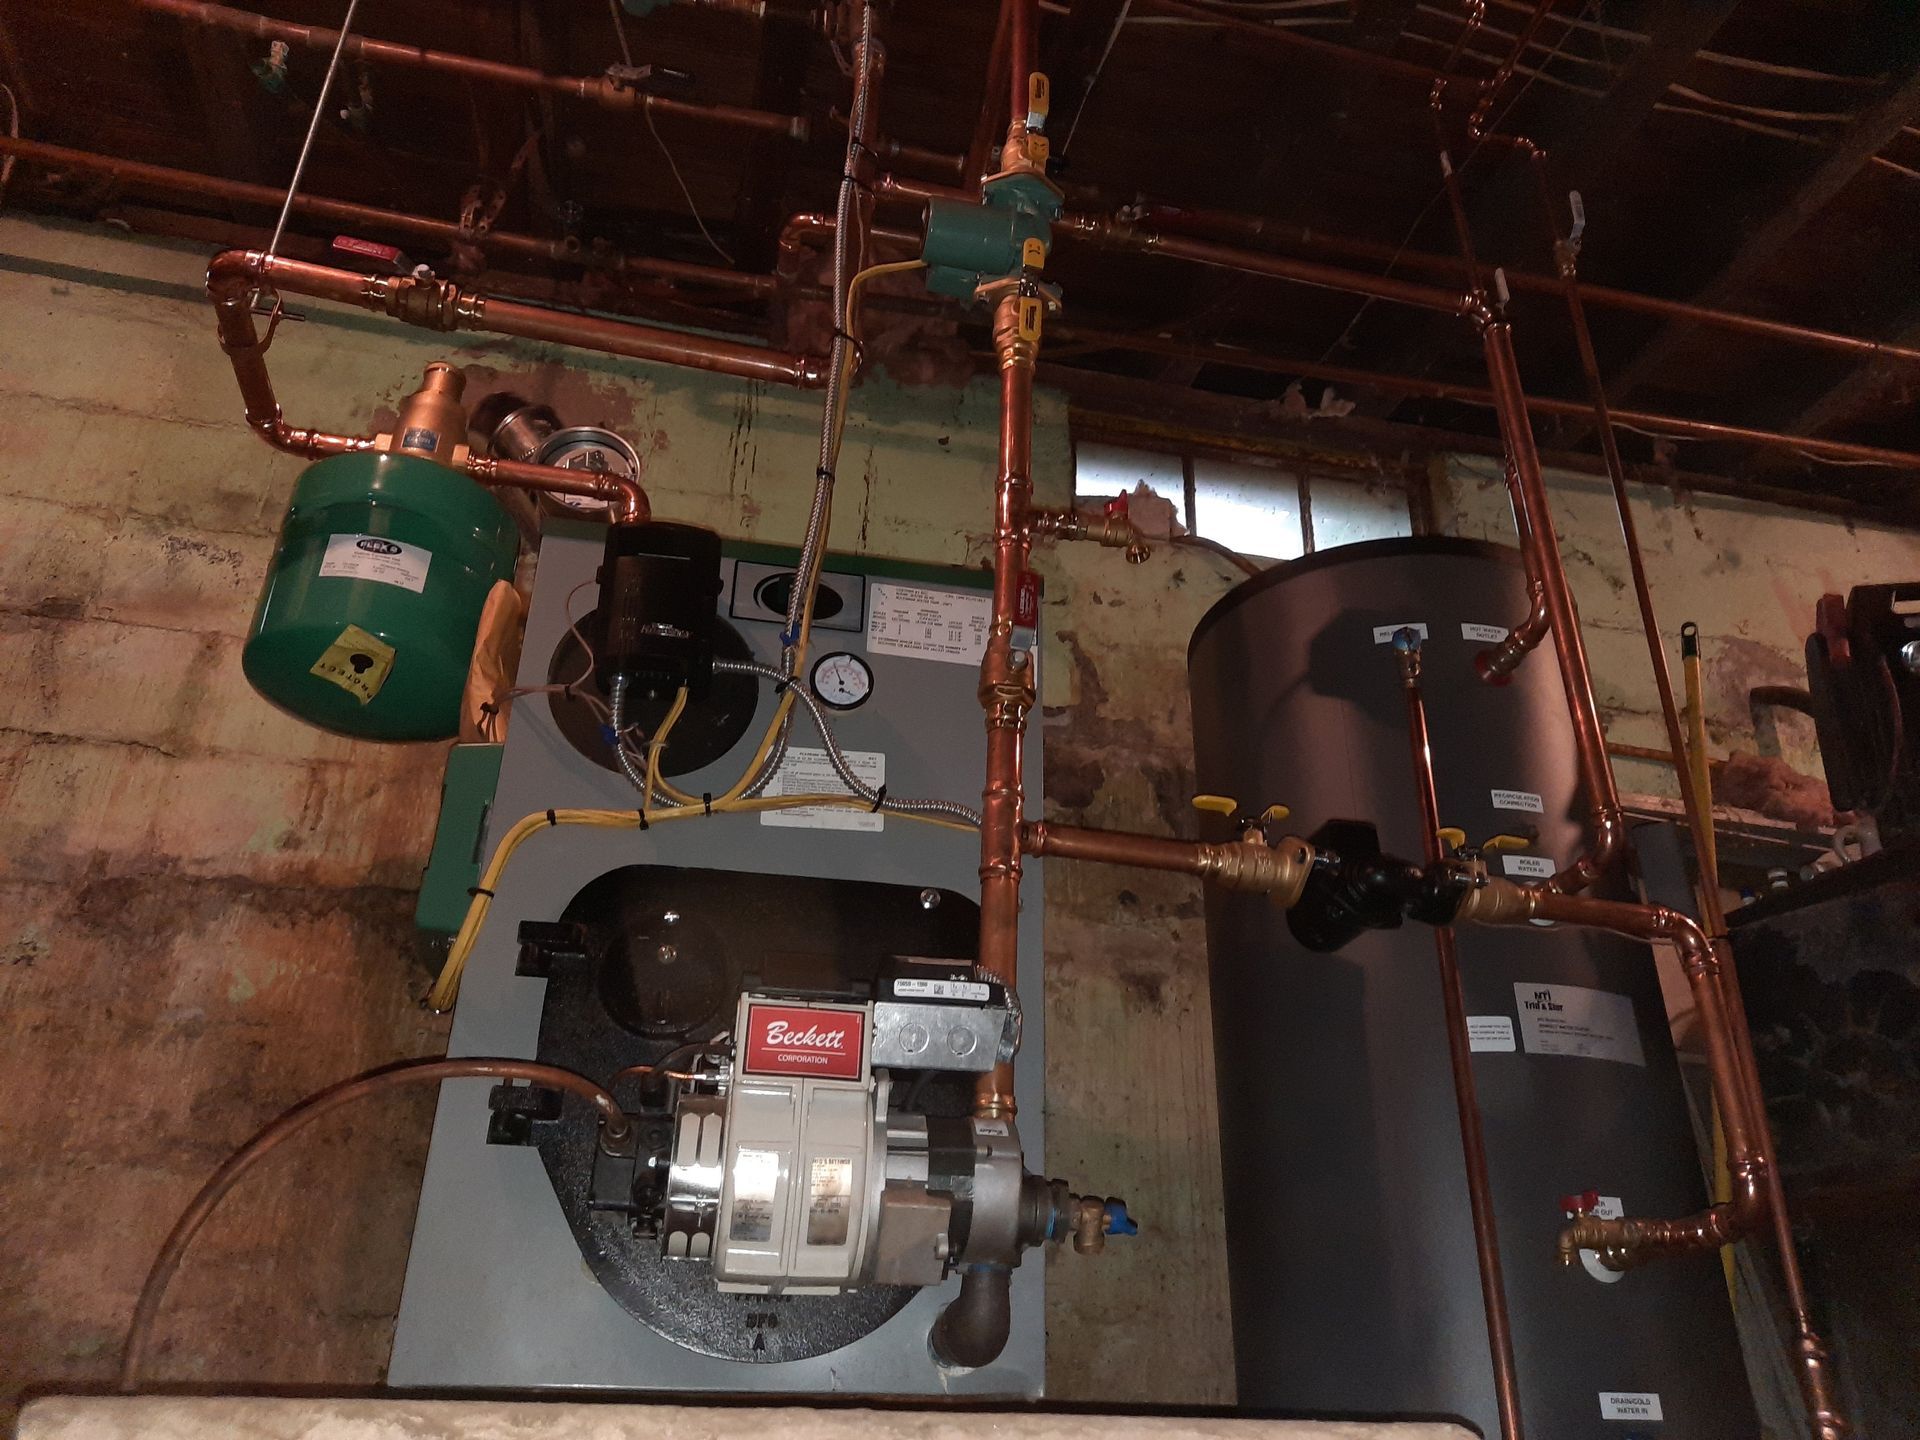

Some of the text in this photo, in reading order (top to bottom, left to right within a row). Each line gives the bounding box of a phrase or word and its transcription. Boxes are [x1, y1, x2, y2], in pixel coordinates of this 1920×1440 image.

[319, 662, 372, 699] PROTECT
[766, 1020, 845, 1049] Beckett
[777, 1054, 828, 1065] CORPORATION
